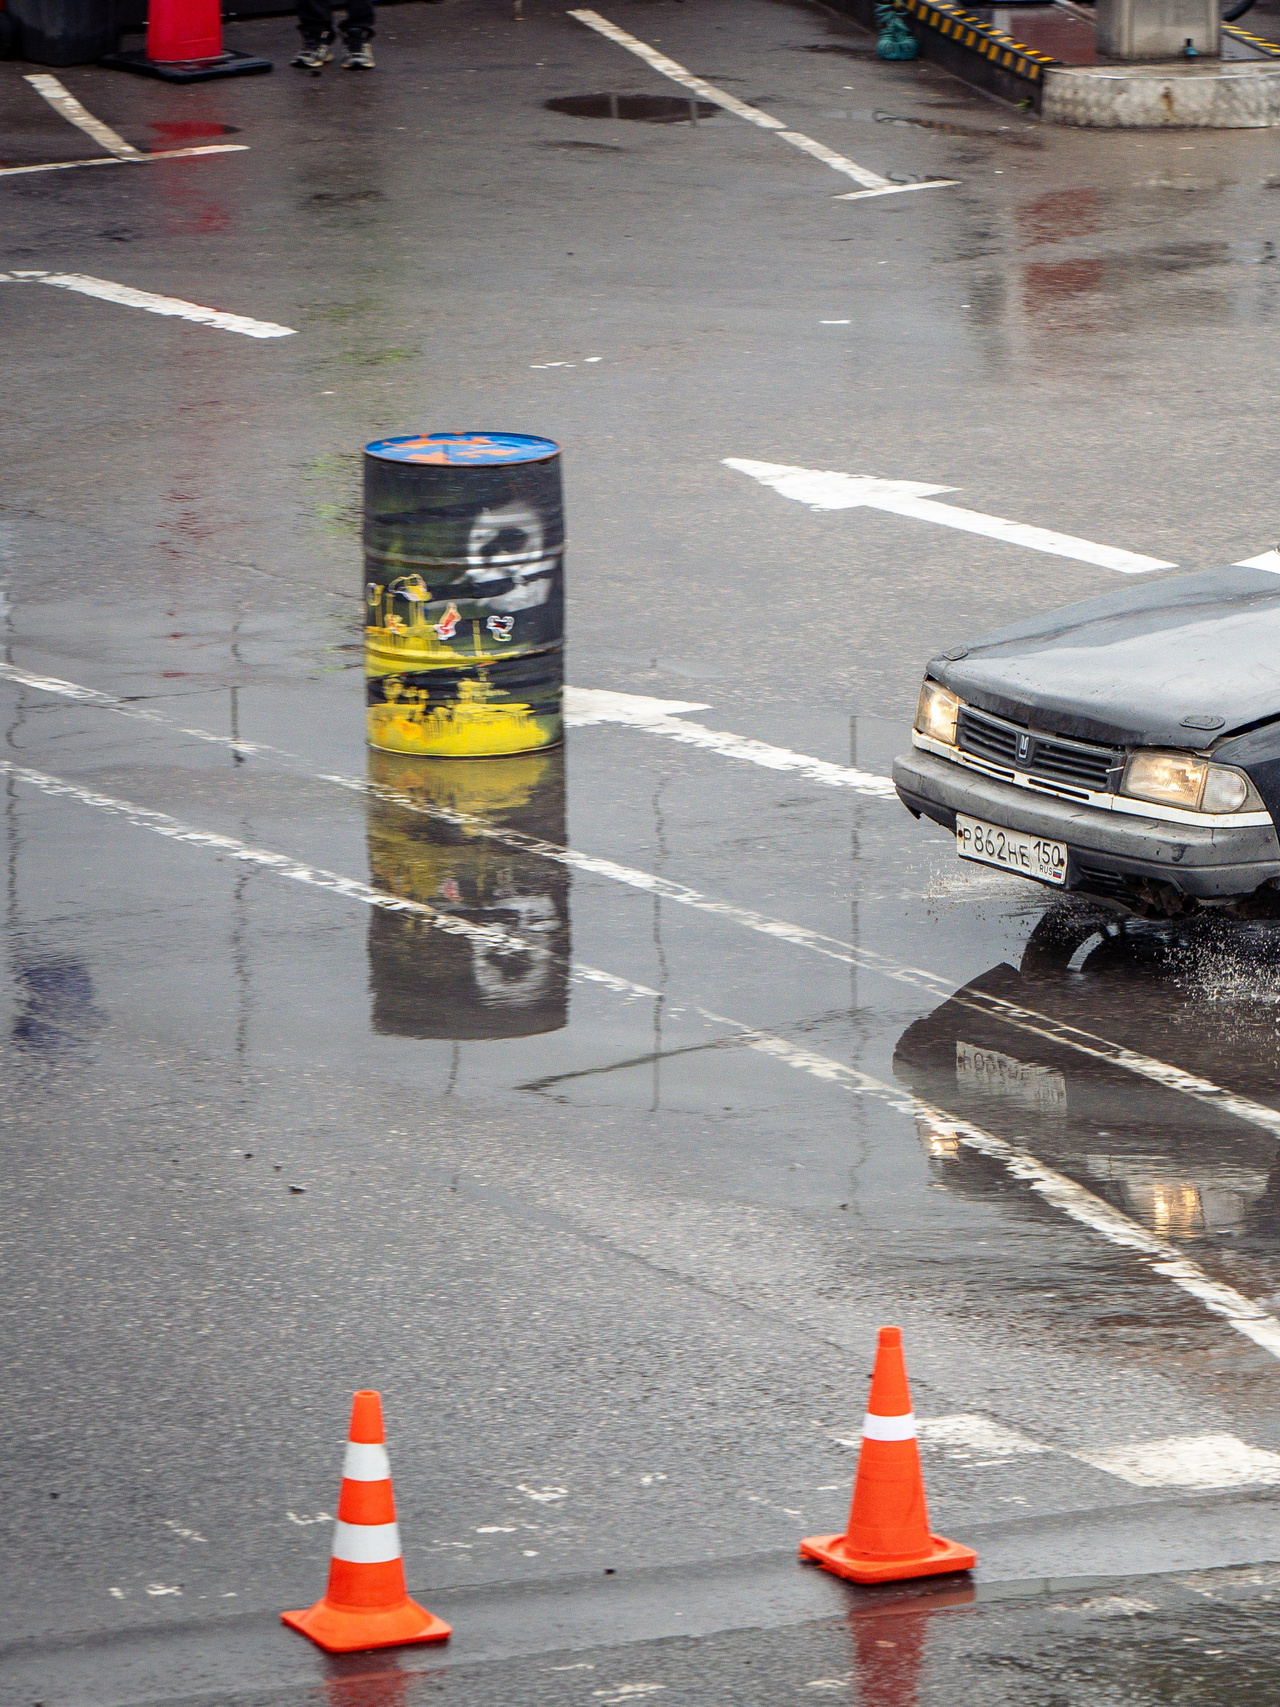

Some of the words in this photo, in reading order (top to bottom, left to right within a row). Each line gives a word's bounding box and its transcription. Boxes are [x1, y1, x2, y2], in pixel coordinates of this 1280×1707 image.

[963, 825, 1030, 868] P862HE
[1033, 840, 1061, 867] 150
[1039, 864, 1053, 876] RUS
